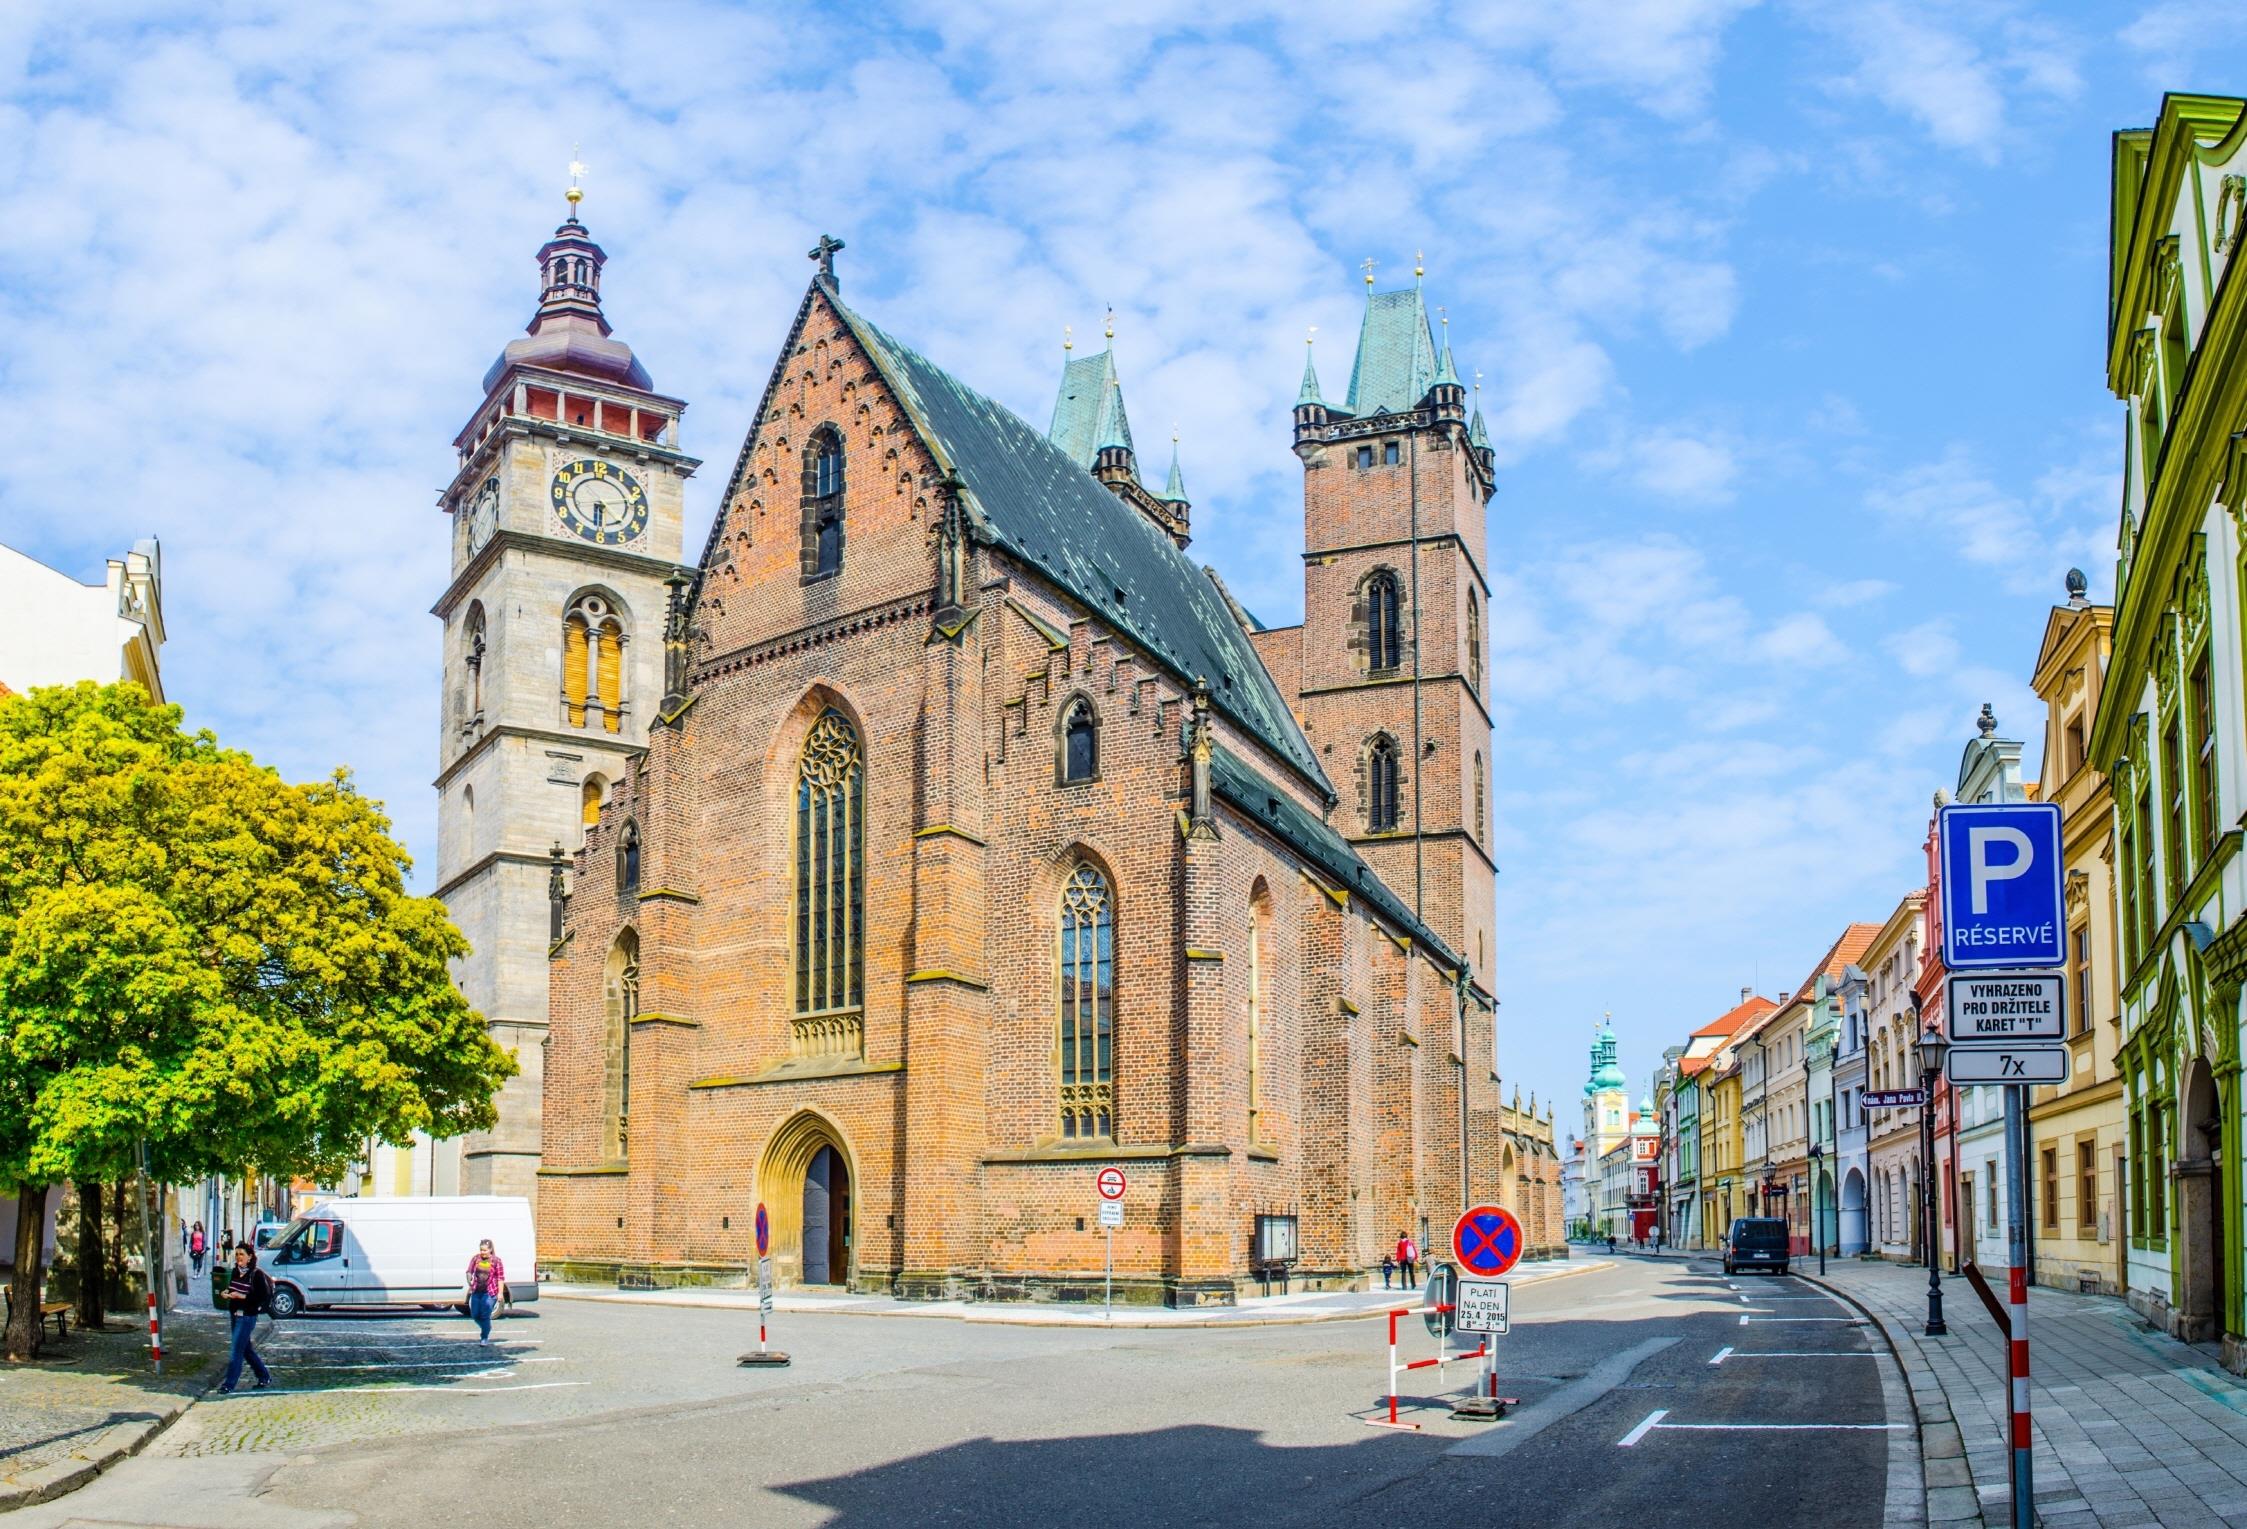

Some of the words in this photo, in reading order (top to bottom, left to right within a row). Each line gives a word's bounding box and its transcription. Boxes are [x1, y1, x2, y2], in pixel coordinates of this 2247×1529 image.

[574, 463, 583, 473] 11
[594, 462, 607, 474] 12
[559, 471, 571, 483] 10
[619, 471, 624, 481] 1
[555, 488, 563, 499] 9
[631, 486, 641, 501] 2
[559, 507, 567, 518] 8
[638, 505, 645, 516] 3
[576, 524, 584, 535] 7
[631, 520, 641, 533] 4
[596, 532, 604, 543] 6
[618, 532, 625, 543] 5
[1968, 827, 2034, 915] P
[1955, 922, 2054, 947] RÉSERVÉ
[1970, 984, 2042, 998] VYHRAZENO
[1963, 1002, 1988, 1015] PRO
[1992, 997, 2051, 1014] DRŽITELE
[1976, 1018, 2016, 1032] KARET
[2019, 1017, 2042, 1031] "T"
[2000, 1055, 2025, 1076] 7x
[1883, 1095, 1897, 1104] Jana
[1899, 1093, 1914, 1103] Pavla
[1464, 1301, 1476, 1309] NA
[1487, 1313, 1504, 1321] 2015
